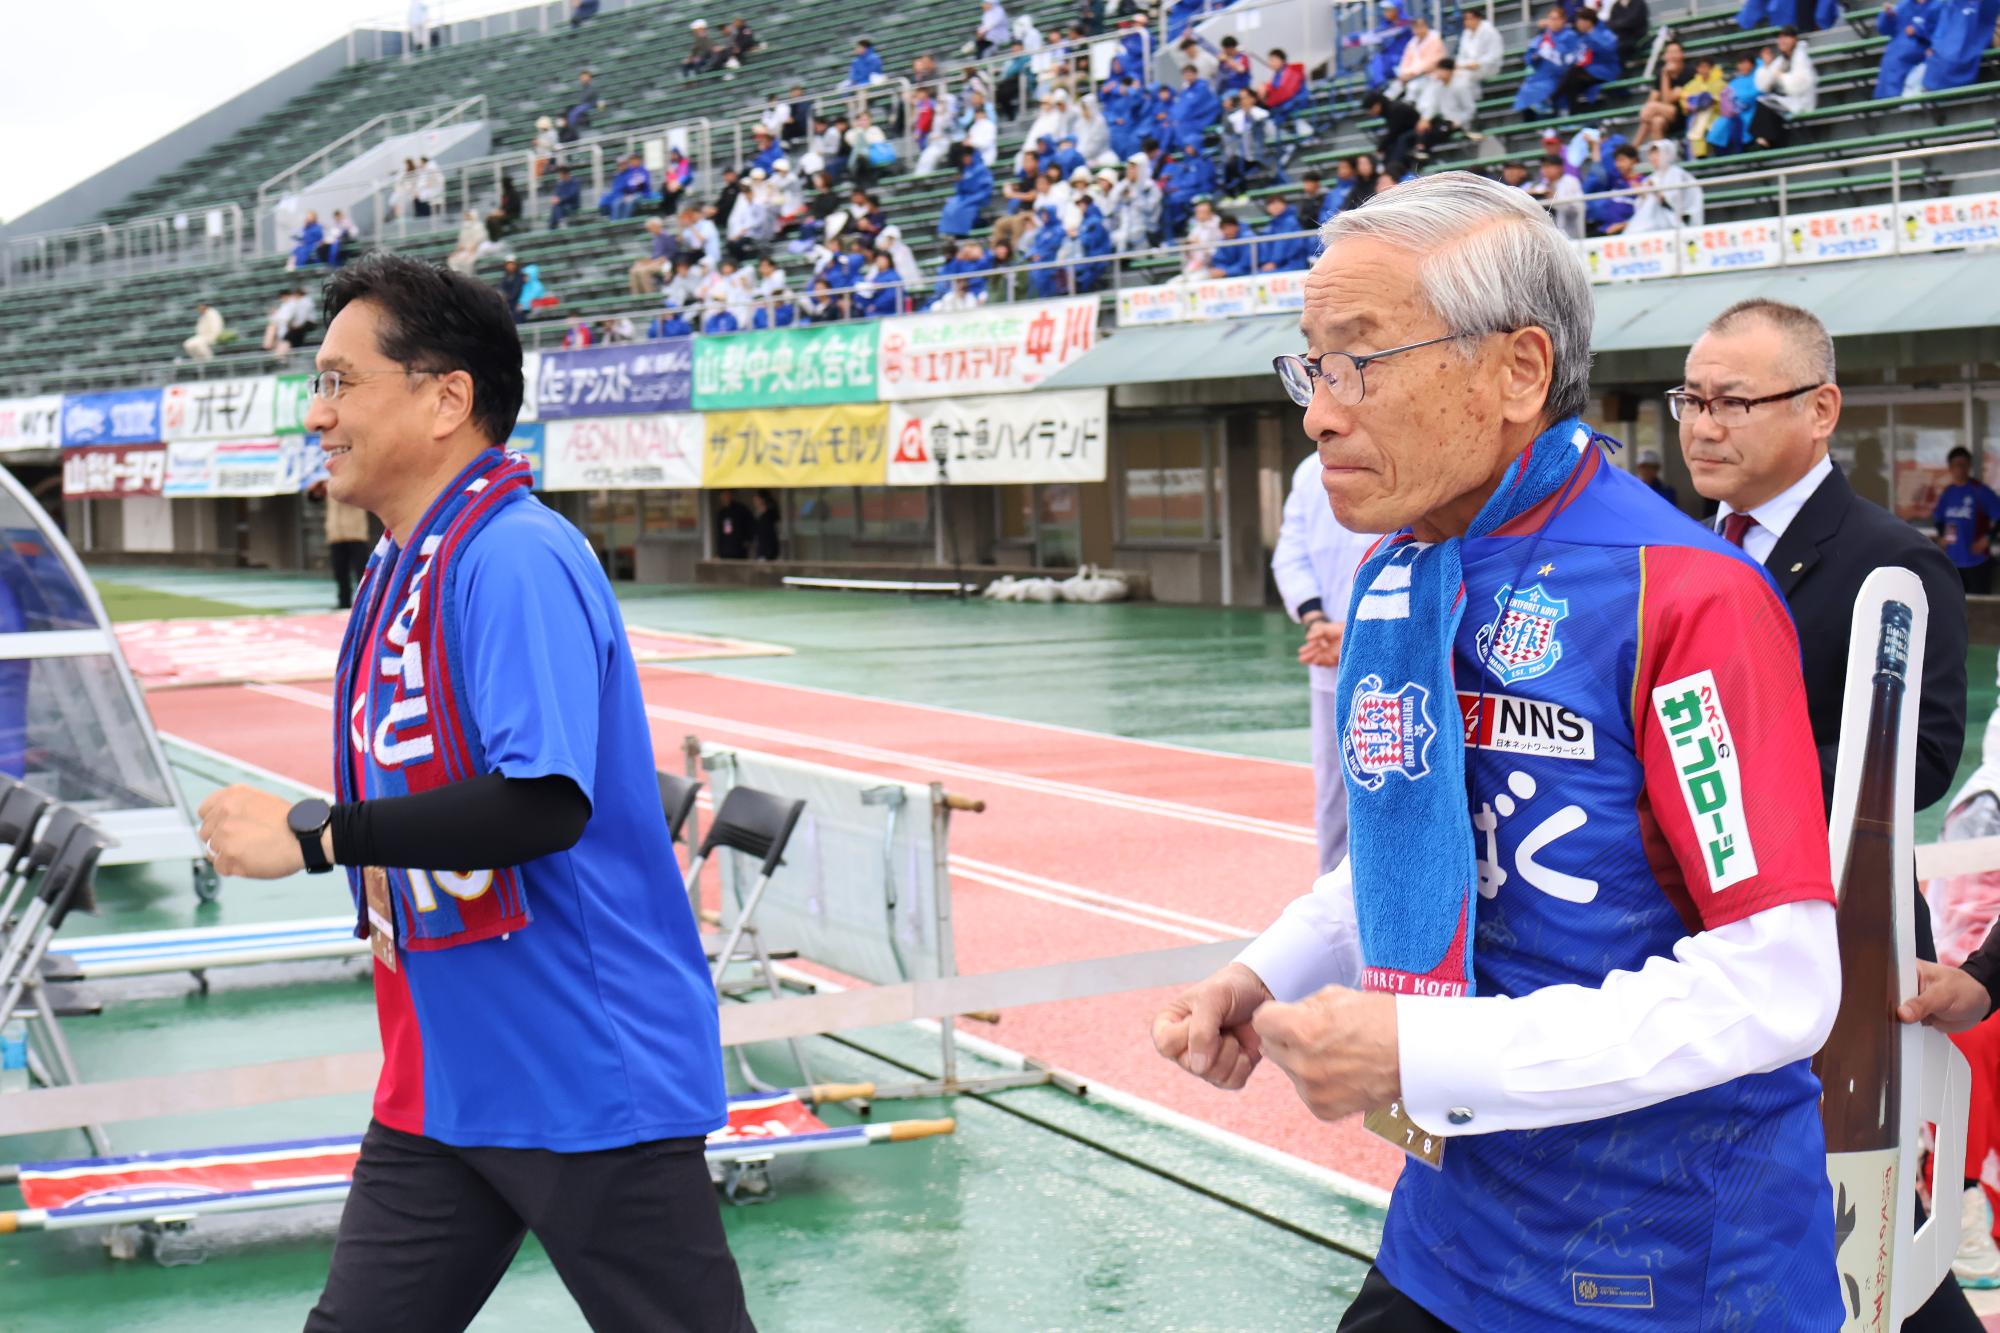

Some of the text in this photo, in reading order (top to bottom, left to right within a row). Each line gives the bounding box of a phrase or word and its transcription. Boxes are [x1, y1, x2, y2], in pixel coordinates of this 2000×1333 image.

[1026, 304, 1094, 365] 中川
[193, 381, 259, 433] オギノ
[931, 416, 1101, 461] 富士急ハイランド
[63, 450, 163, 494] 山梨トヨタ
[1505, 596, 1541, 614] ENTFORET
[1402, 695, 1416, 768] VENTFORET KOFU
[1500, 699, 1586, 743] NNS
[1700, 685, 1731, 760] クスリの
[1496, 738, 1587, 757] 日本ネットワークサービス
[1660, 688, 1736, 879] サンロード
[1413, 977, 1463, 998] KOFU
